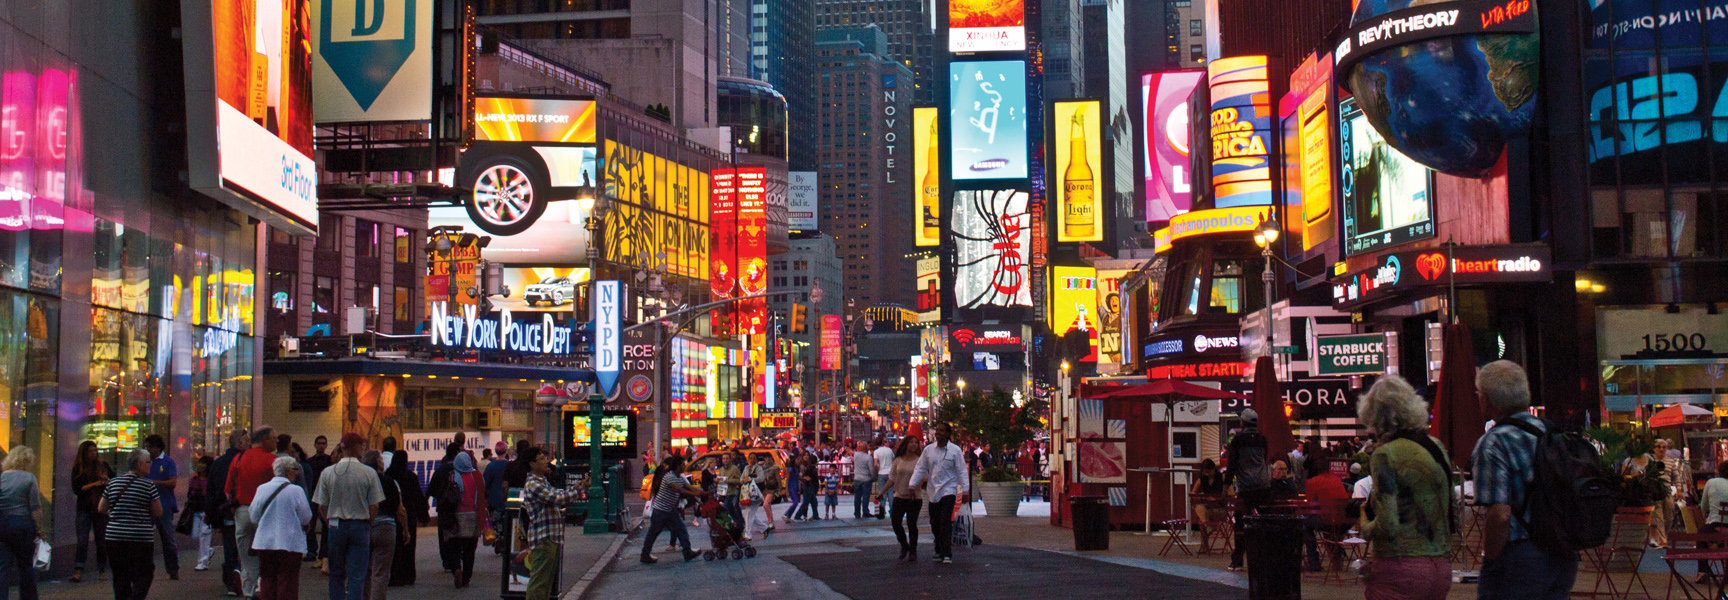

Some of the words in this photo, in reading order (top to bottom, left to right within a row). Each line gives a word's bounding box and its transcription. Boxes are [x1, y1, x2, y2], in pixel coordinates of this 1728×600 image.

[1481, 6, 1504, 29] LITA
[966, 31, 1008, 40] XINHUA
[507, 113, 526, 122] 2013
[526, 114, 538, 122] RX
[544, 115, 569, 123] SPORT
[884, 91, 896, 183] NOVOTEL
[281, 154, 293, 191] 3rd
[294, 161, 312, 202] Floor
[795, 174, 805, 183] By
[673, 183, 688, 206] THE
[788, 183, 814, 192] George,
[1065, 182, 1093, 192] Corona
[790, 199, 802, 207] did
[802, 199, 810, 207] it.
[1069, 203, 1091, 215] Light
[658, 206, 681, 249] LION
[683, 214, 706, 260] KING
[992, 213, 1022, 295] Coke
[440, 262, 474, 275] GMP
[1452, 256, 1541, 273] iheartradio
[431, 301, 463, 345] NEW
[464, 304, 498, 348] YORK
[500, 308, 541, 352] POLICE
[543, 313, 571, 354] DEPT
[602, 284, 613, 367] NYPD
[984, 330, 1010, 338] SEARCH
[1207, 337, 1238, 348] NEWS
[1642, 333, 1706, 352] 1500
[1332, 354, 1379, 366] COFFEE
[1228, 388, 1347, 408] SEHORA
